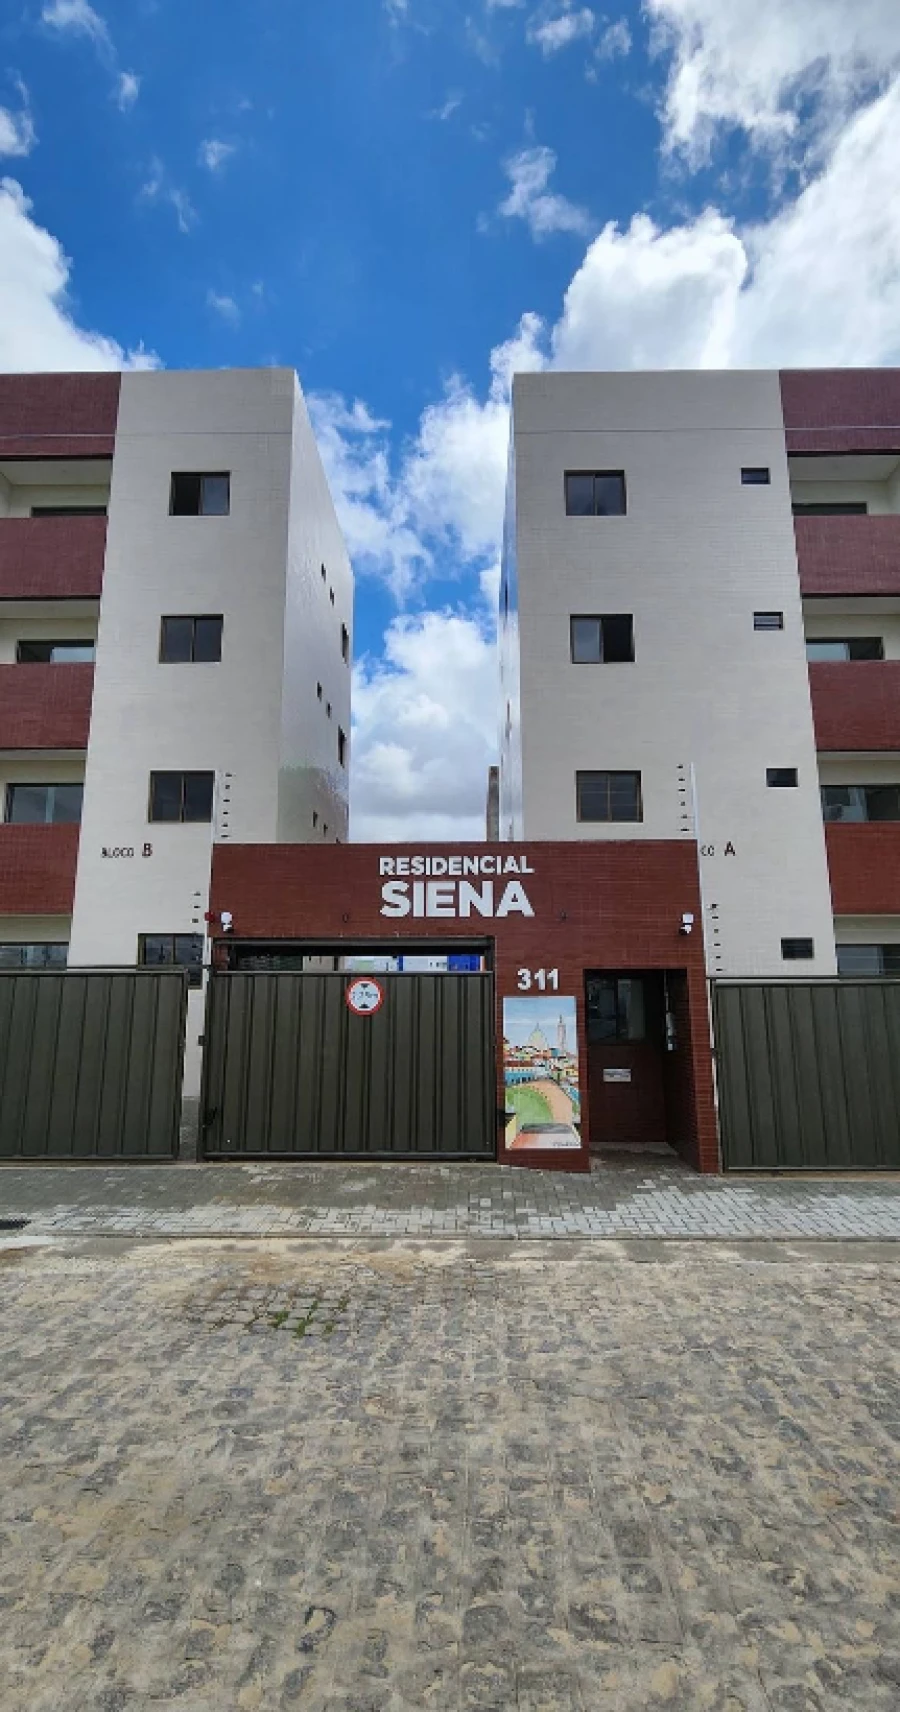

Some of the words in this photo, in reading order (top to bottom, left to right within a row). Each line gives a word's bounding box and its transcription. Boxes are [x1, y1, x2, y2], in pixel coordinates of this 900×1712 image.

[142, 842, 153, 858] B
[724, 841, 735, 856] A
[379, 855, 535, 875] RESIDENCIAL
[379, 880, 535, 917] SIENA
[517, 968, 558, 990] 311
